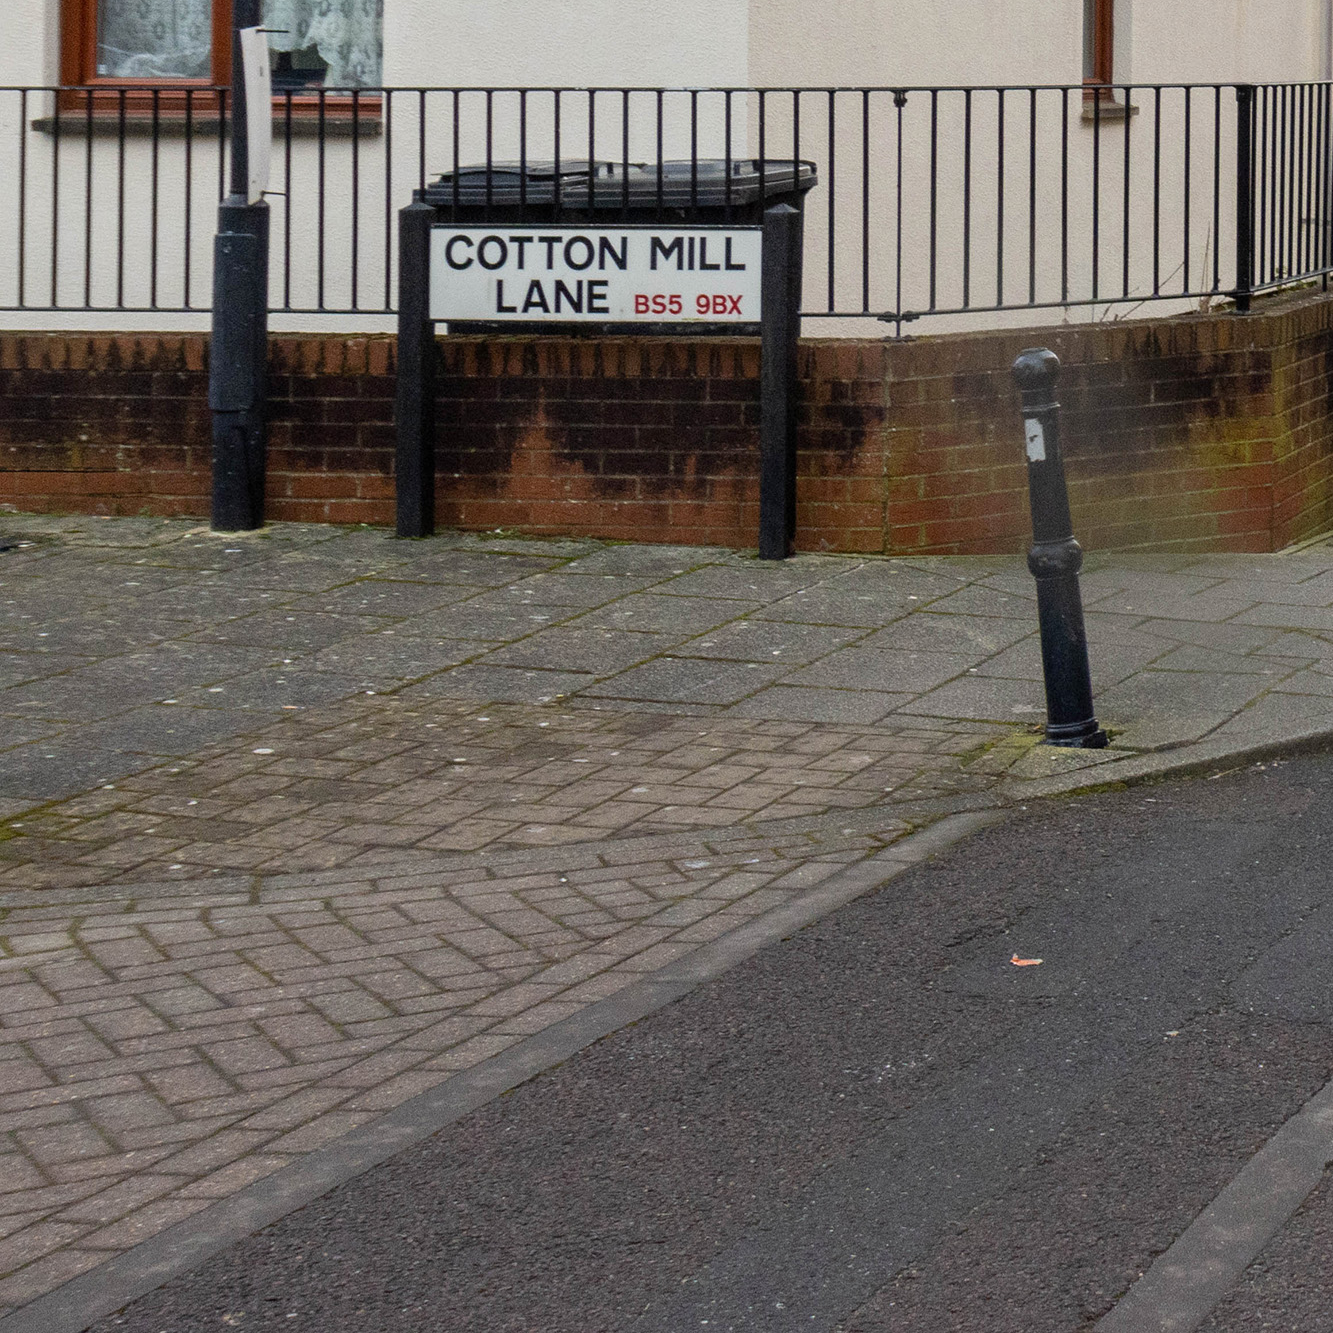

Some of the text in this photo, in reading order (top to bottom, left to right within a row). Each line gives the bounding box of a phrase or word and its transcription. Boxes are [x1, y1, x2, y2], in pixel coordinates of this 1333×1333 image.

[445, 234, 747, 271] COTTON MILL
[496, 279, 743, 315] LANE BS5 9BX
